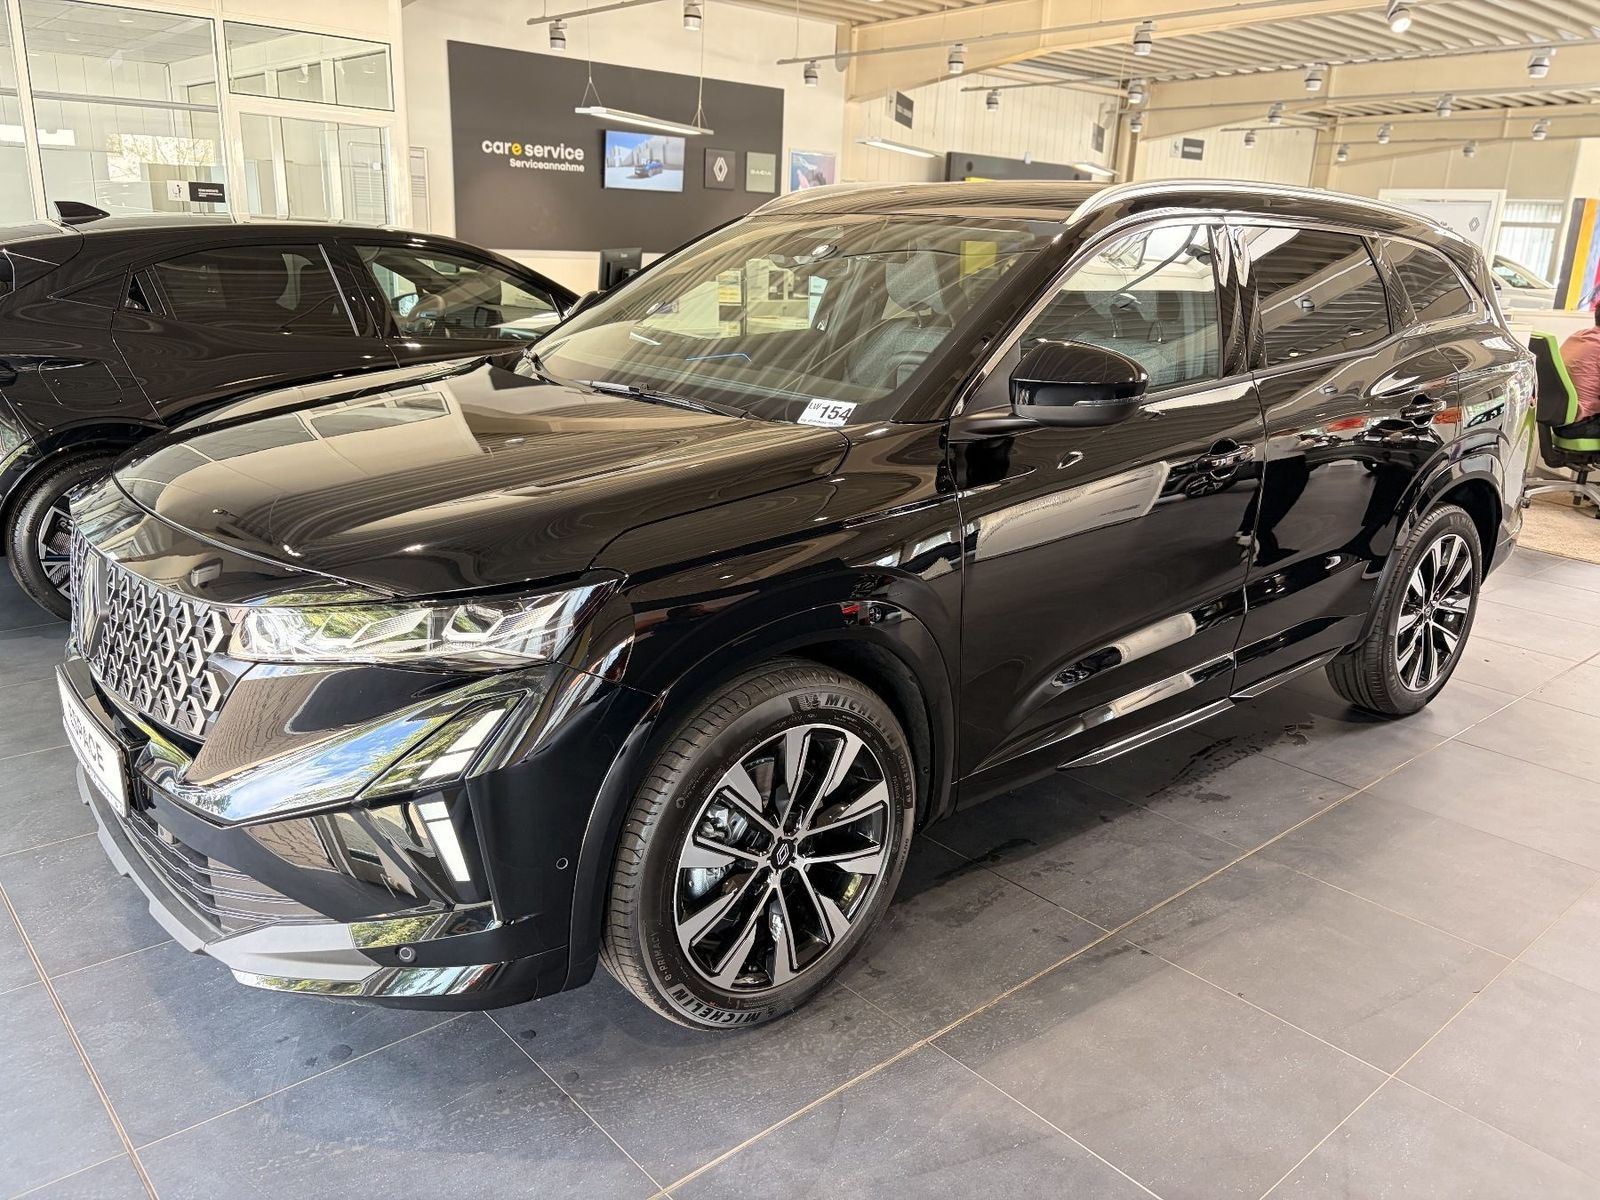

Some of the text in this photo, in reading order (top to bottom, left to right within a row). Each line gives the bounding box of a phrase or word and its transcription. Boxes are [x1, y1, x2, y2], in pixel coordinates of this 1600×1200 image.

[481, 140, 585, 161] care service
[509, 158, 585, 172] Serviceannahme
[808, 402, 822, 410] LW
[819, 404, 853, 421] 154
[824, 693, 897, 745] MICHELIN
[671, 987, 763, 1024] MICHELIN
